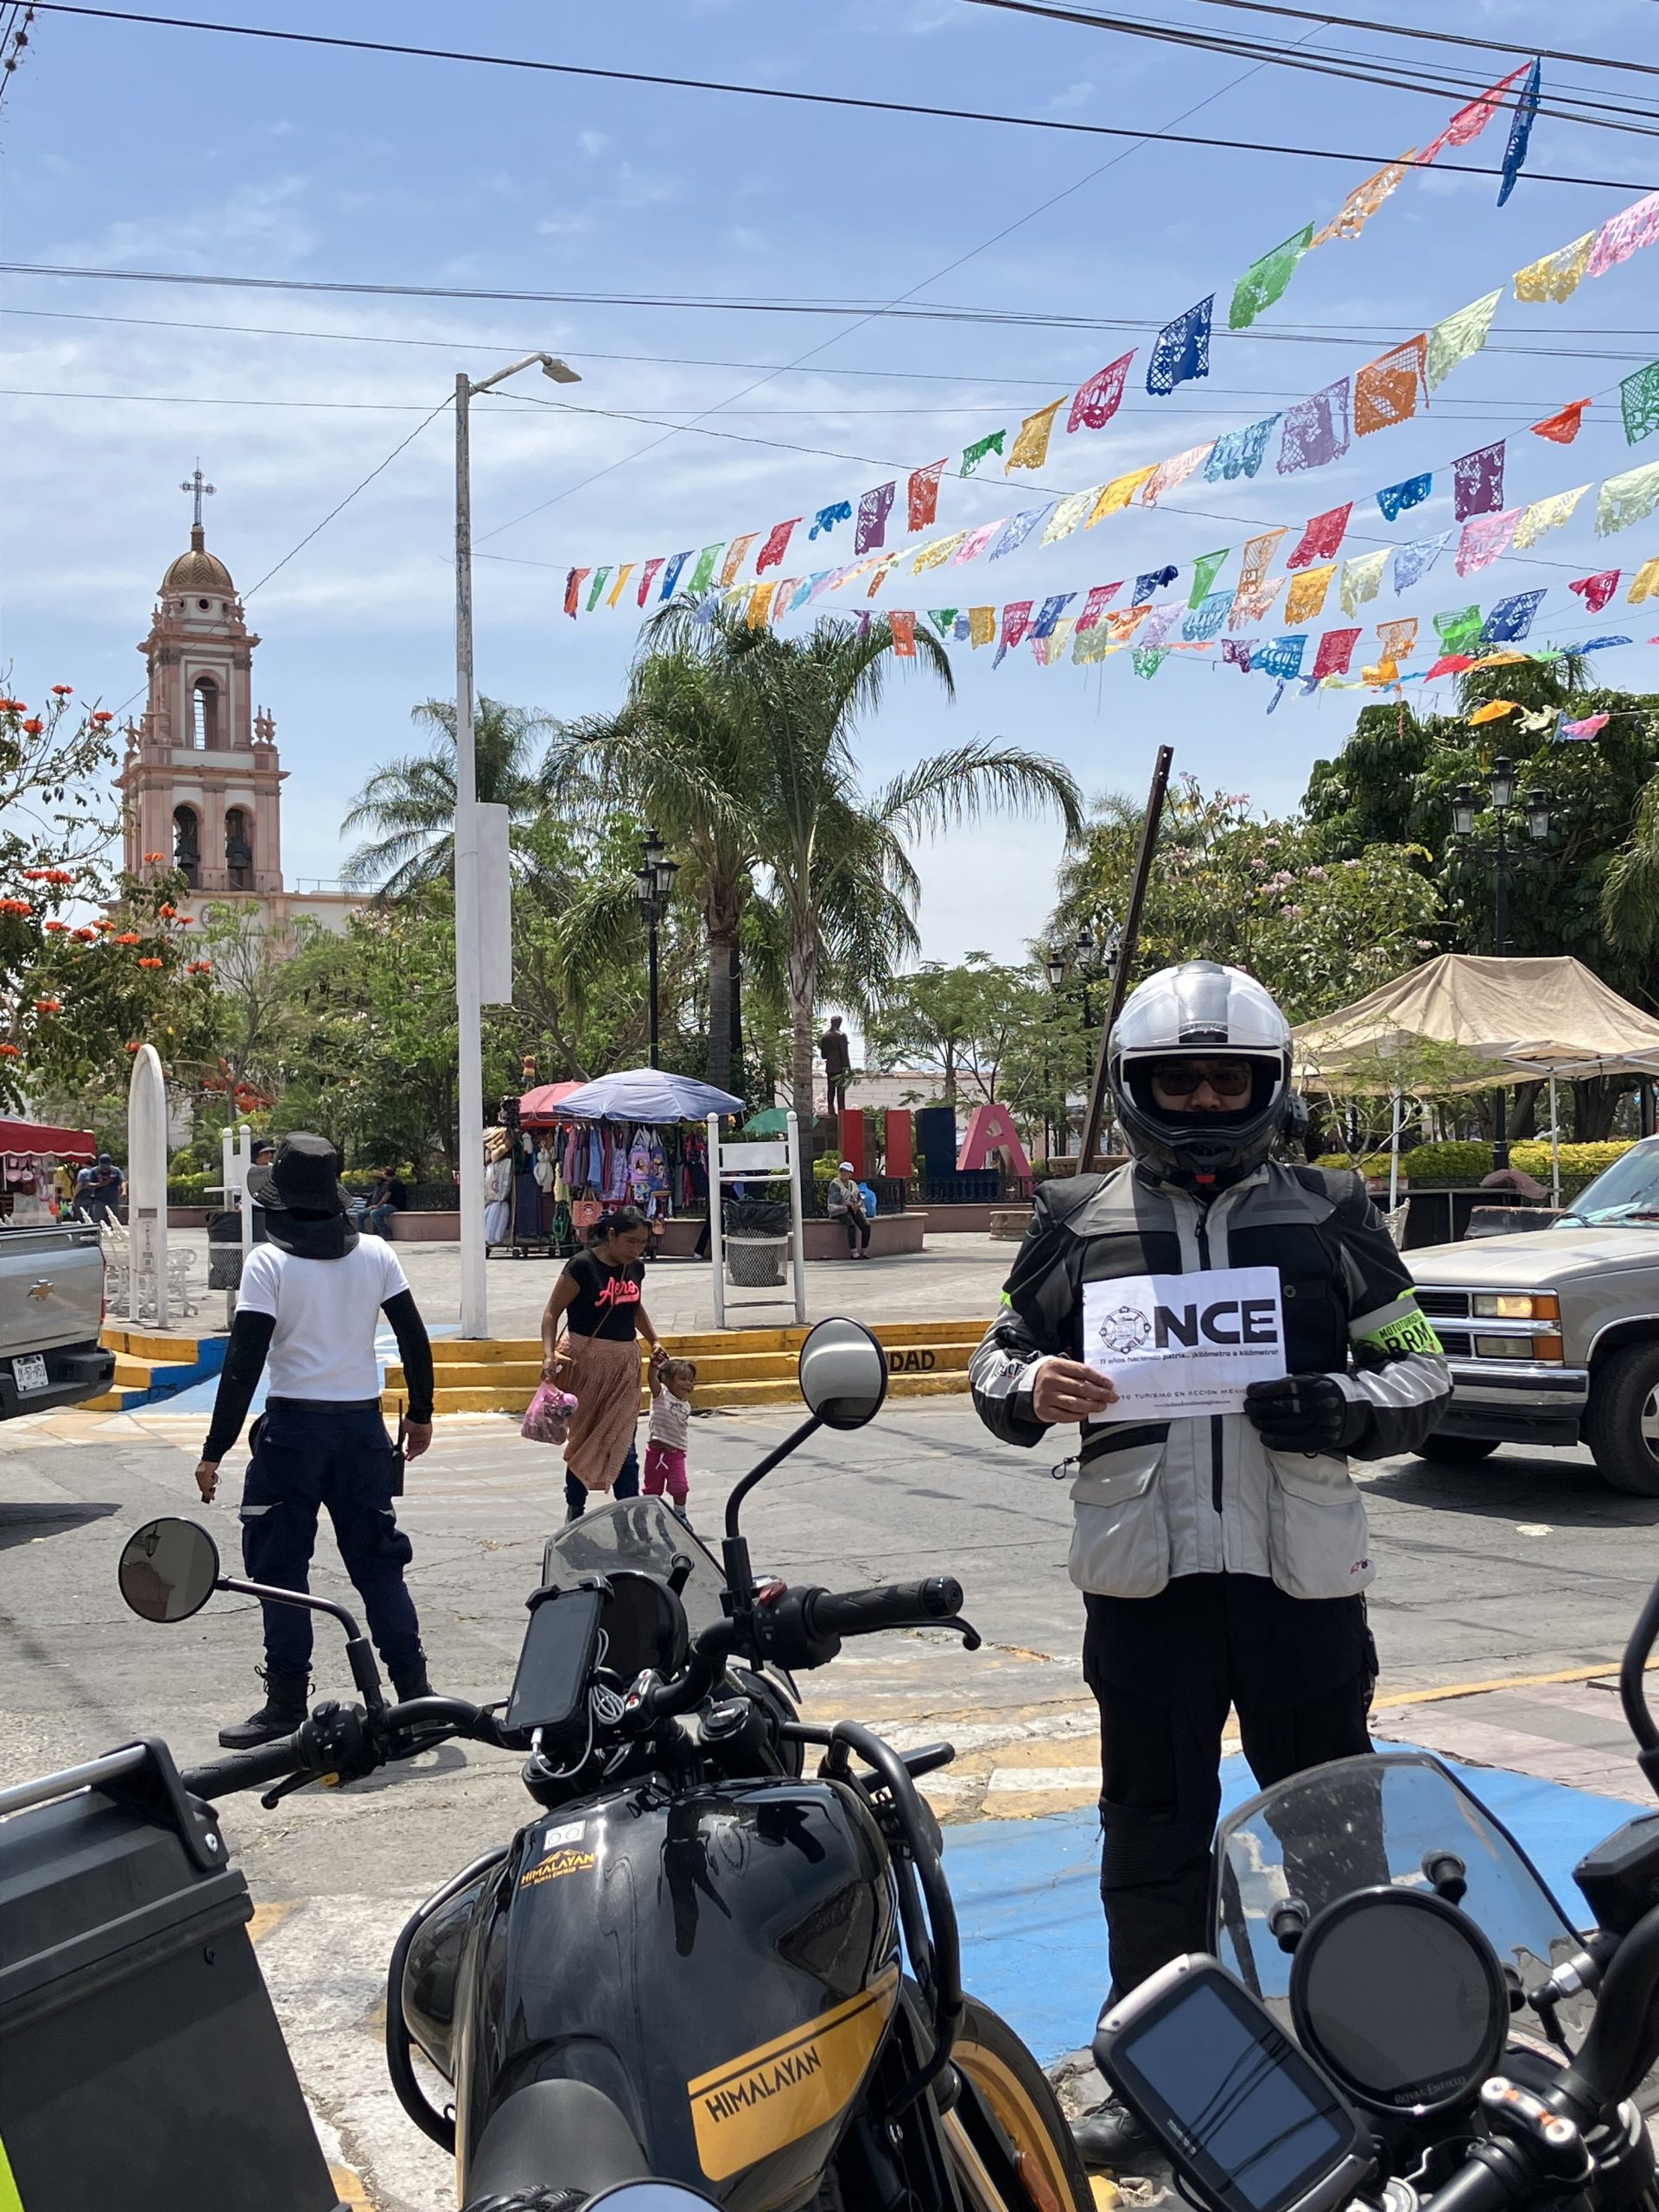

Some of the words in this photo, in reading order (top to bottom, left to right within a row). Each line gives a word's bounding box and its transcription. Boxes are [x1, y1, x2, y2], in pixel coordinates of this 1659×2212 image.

[889, 1349, 936, 1372] DAD
[1127, 1354, 1161, 1363] haciendo
[521, 1852, 594, 1885] HIMALAYAN
[704, 2044, 822, 2124] HIMALAYAN
